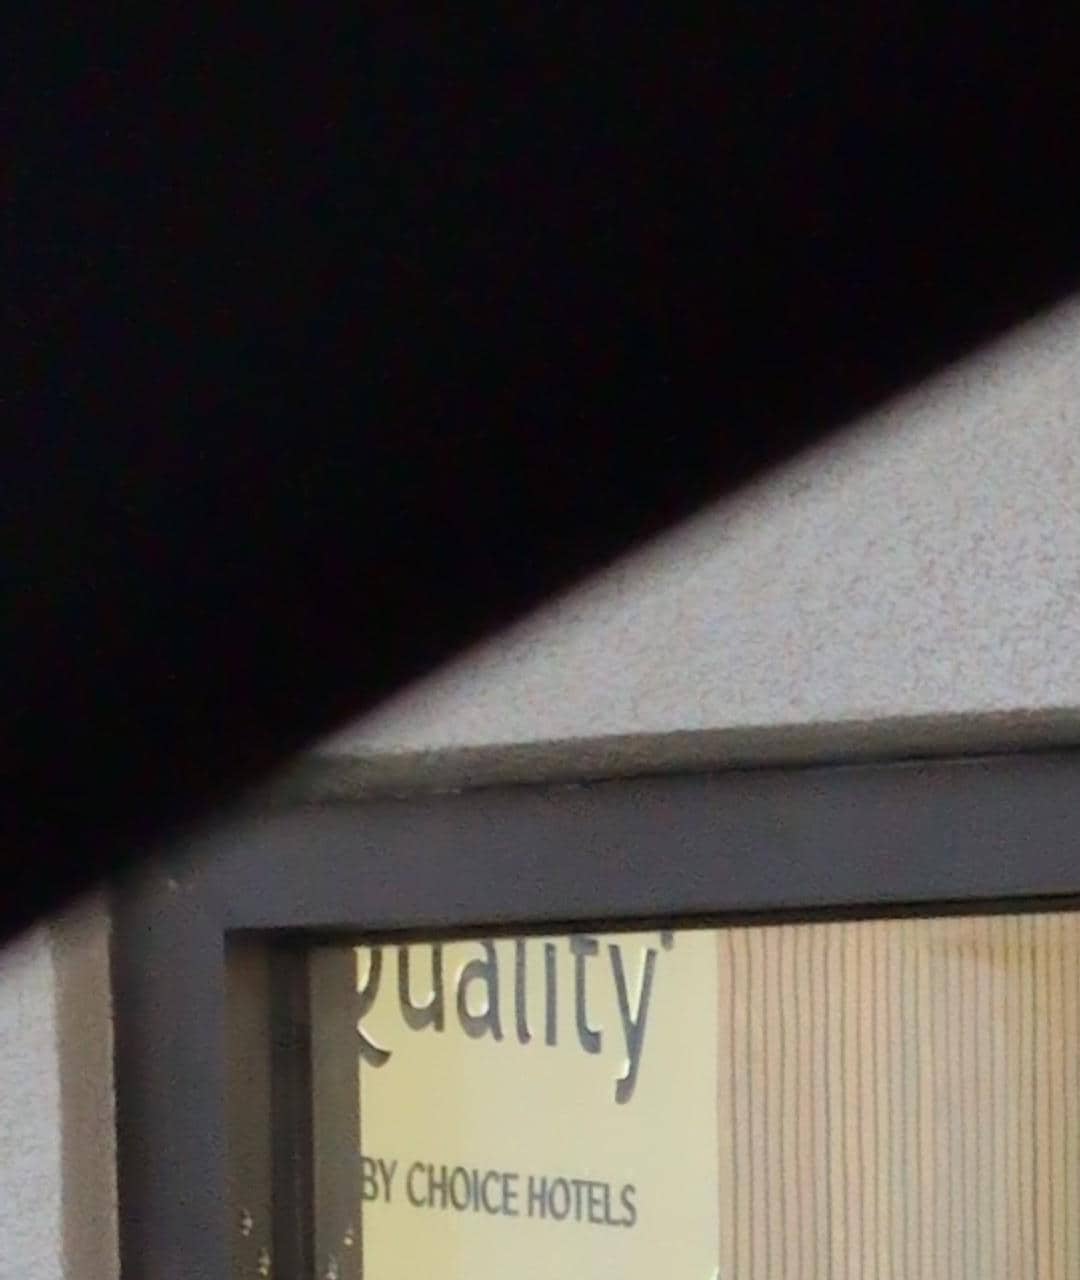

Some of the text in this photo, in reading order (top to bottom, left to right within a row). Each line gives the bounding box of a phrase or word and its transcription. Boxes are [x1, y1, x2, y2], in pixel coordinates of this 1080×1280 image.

[360, 1156, 637, 1228] BY CHOICE HOTELS
